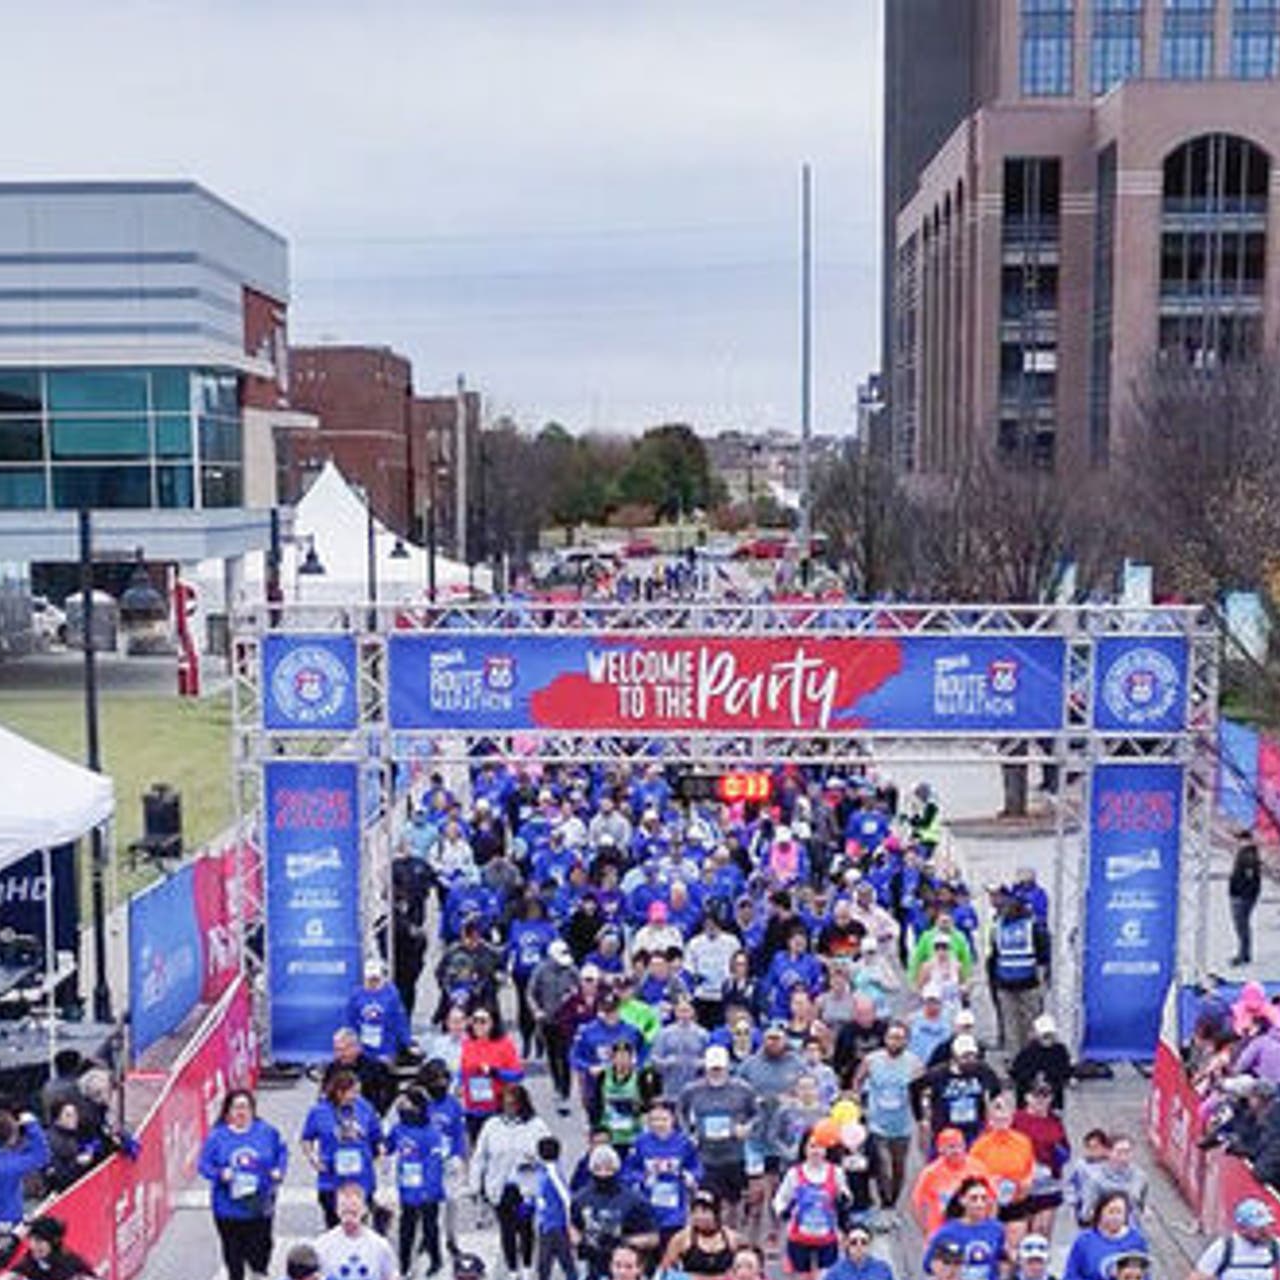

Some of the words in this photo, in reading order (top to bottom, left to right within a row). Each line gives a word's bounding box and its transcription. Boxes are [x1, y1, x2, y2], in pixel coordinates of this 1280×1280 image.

[586, 650, 694, 684] WELCOME
[619, 686, 648, 719] TO
[655, 685, 693, 719] THE
[698, 645, 838, 728] Party
[935, 676, 987, 696] ROUTE
